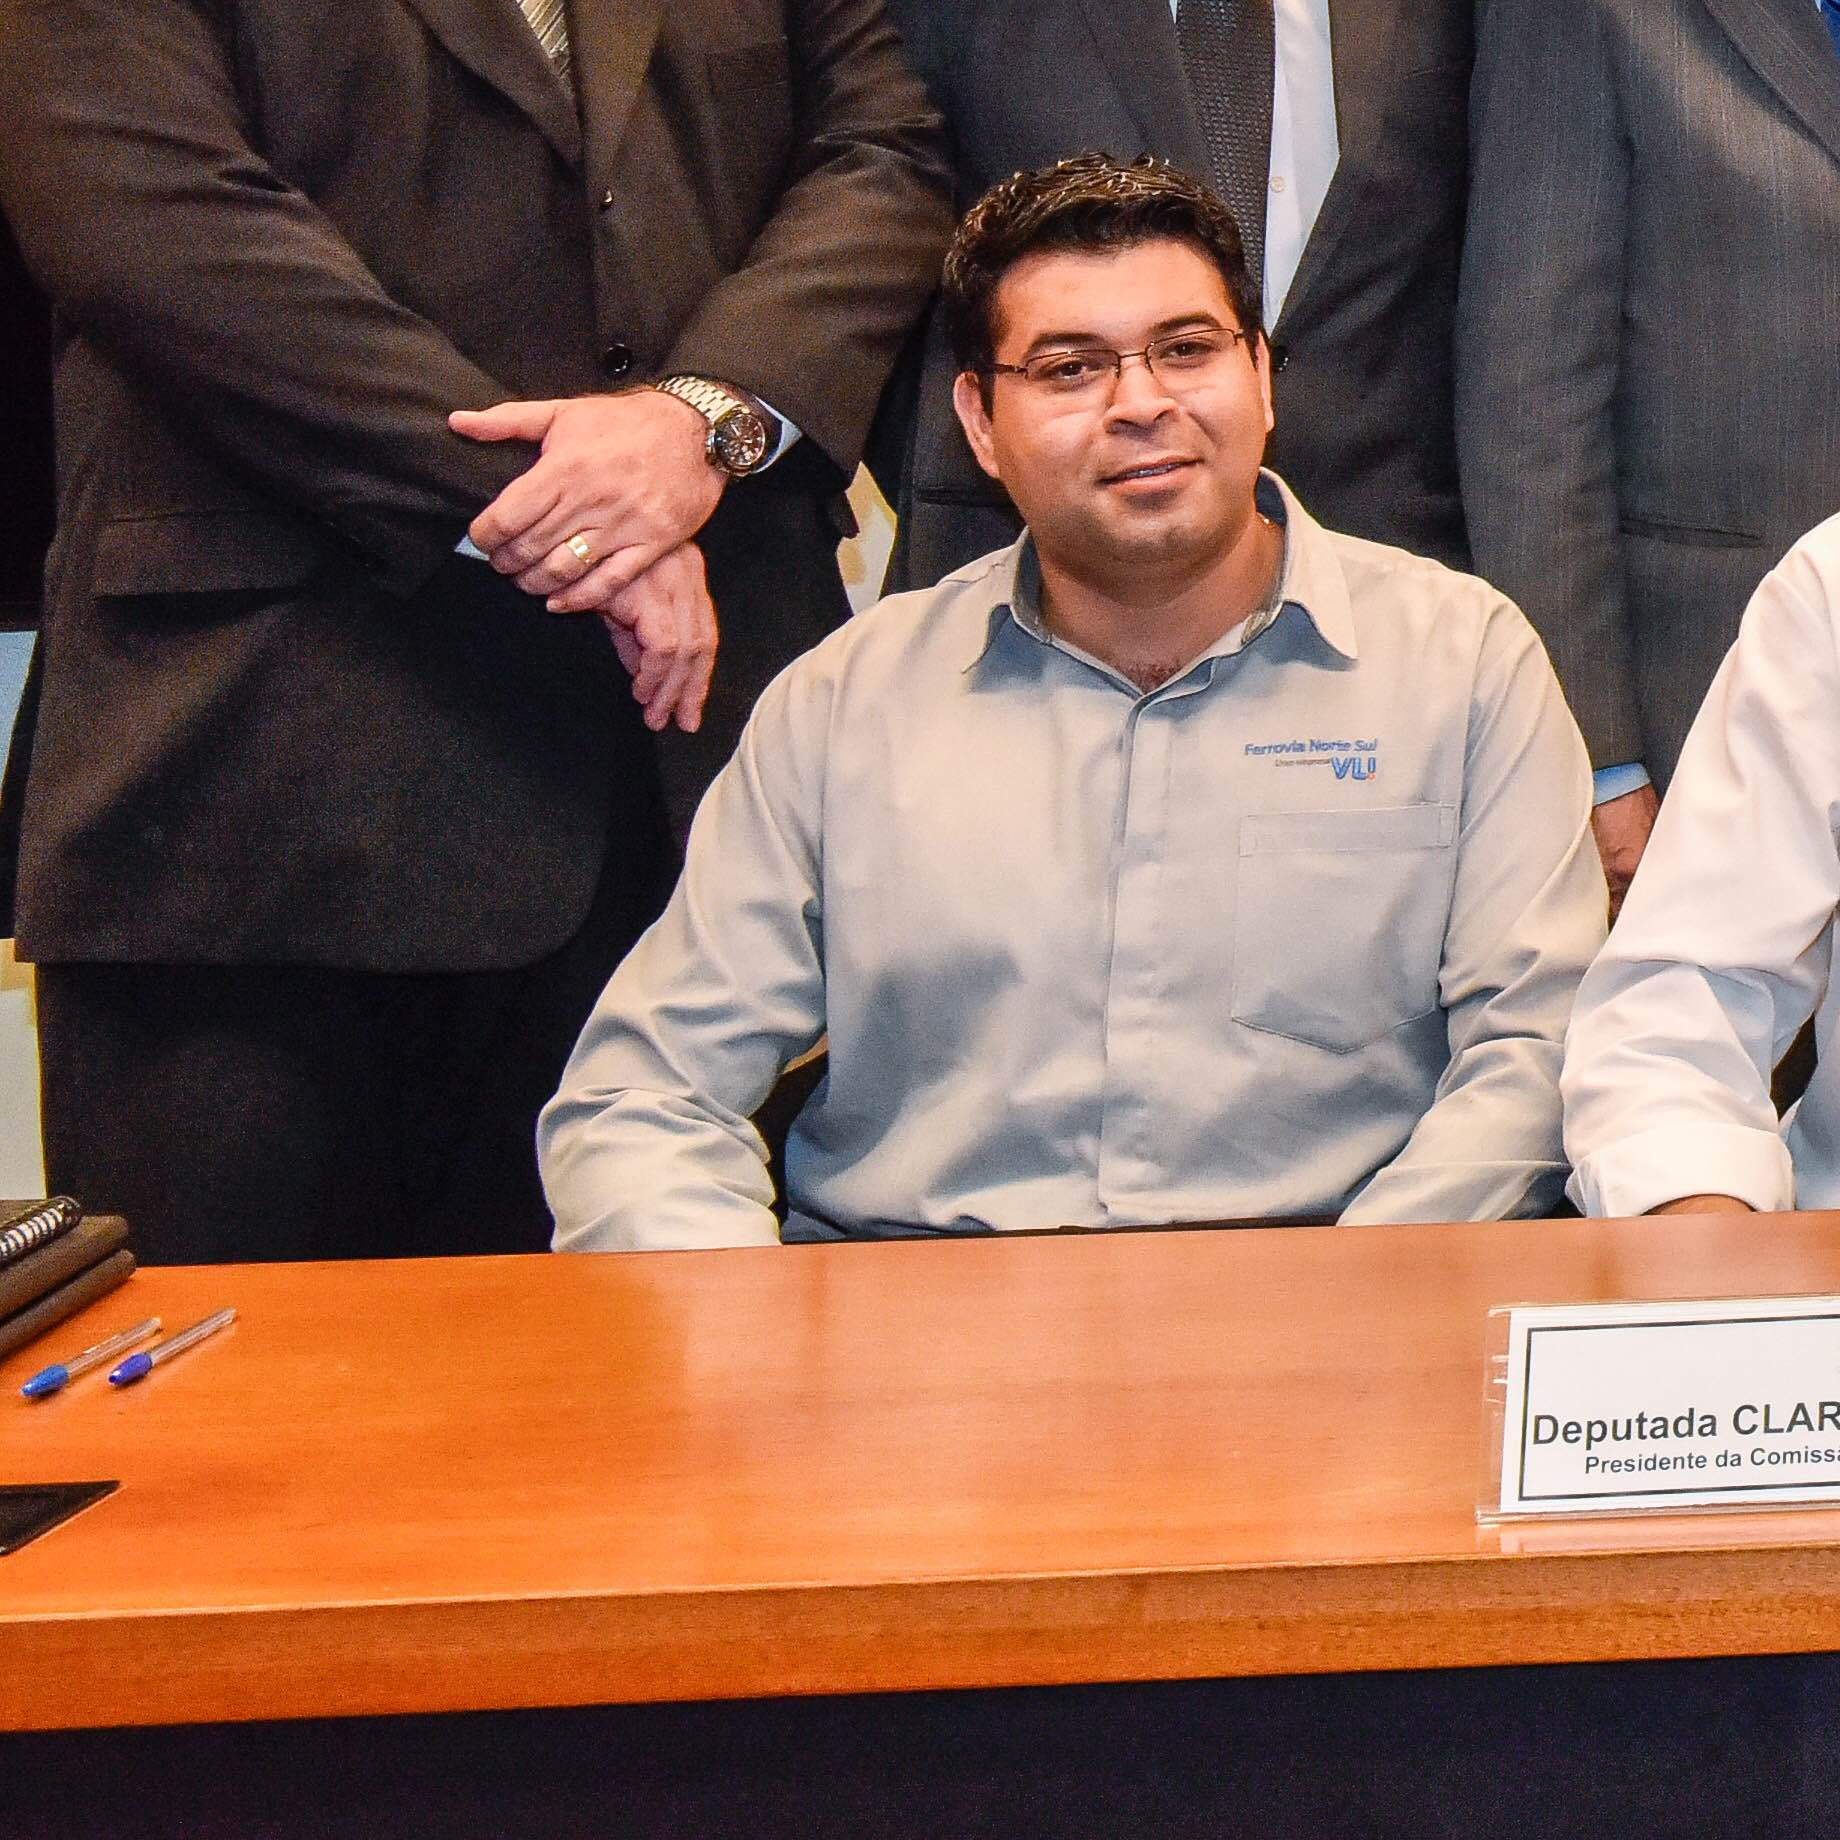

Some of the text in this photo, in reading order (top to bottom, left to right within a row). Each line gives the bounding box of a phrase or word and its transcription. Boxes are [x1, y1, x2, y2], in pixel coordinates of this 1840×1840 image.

[1244, 738, 1377, 755] Ferrovia Norte Sul
[1533, 1407, 1717, 1451] Deputada
[1585, 1450, 1708, 1474] Presidente
[1715, 1449, 1742, 1467] da
